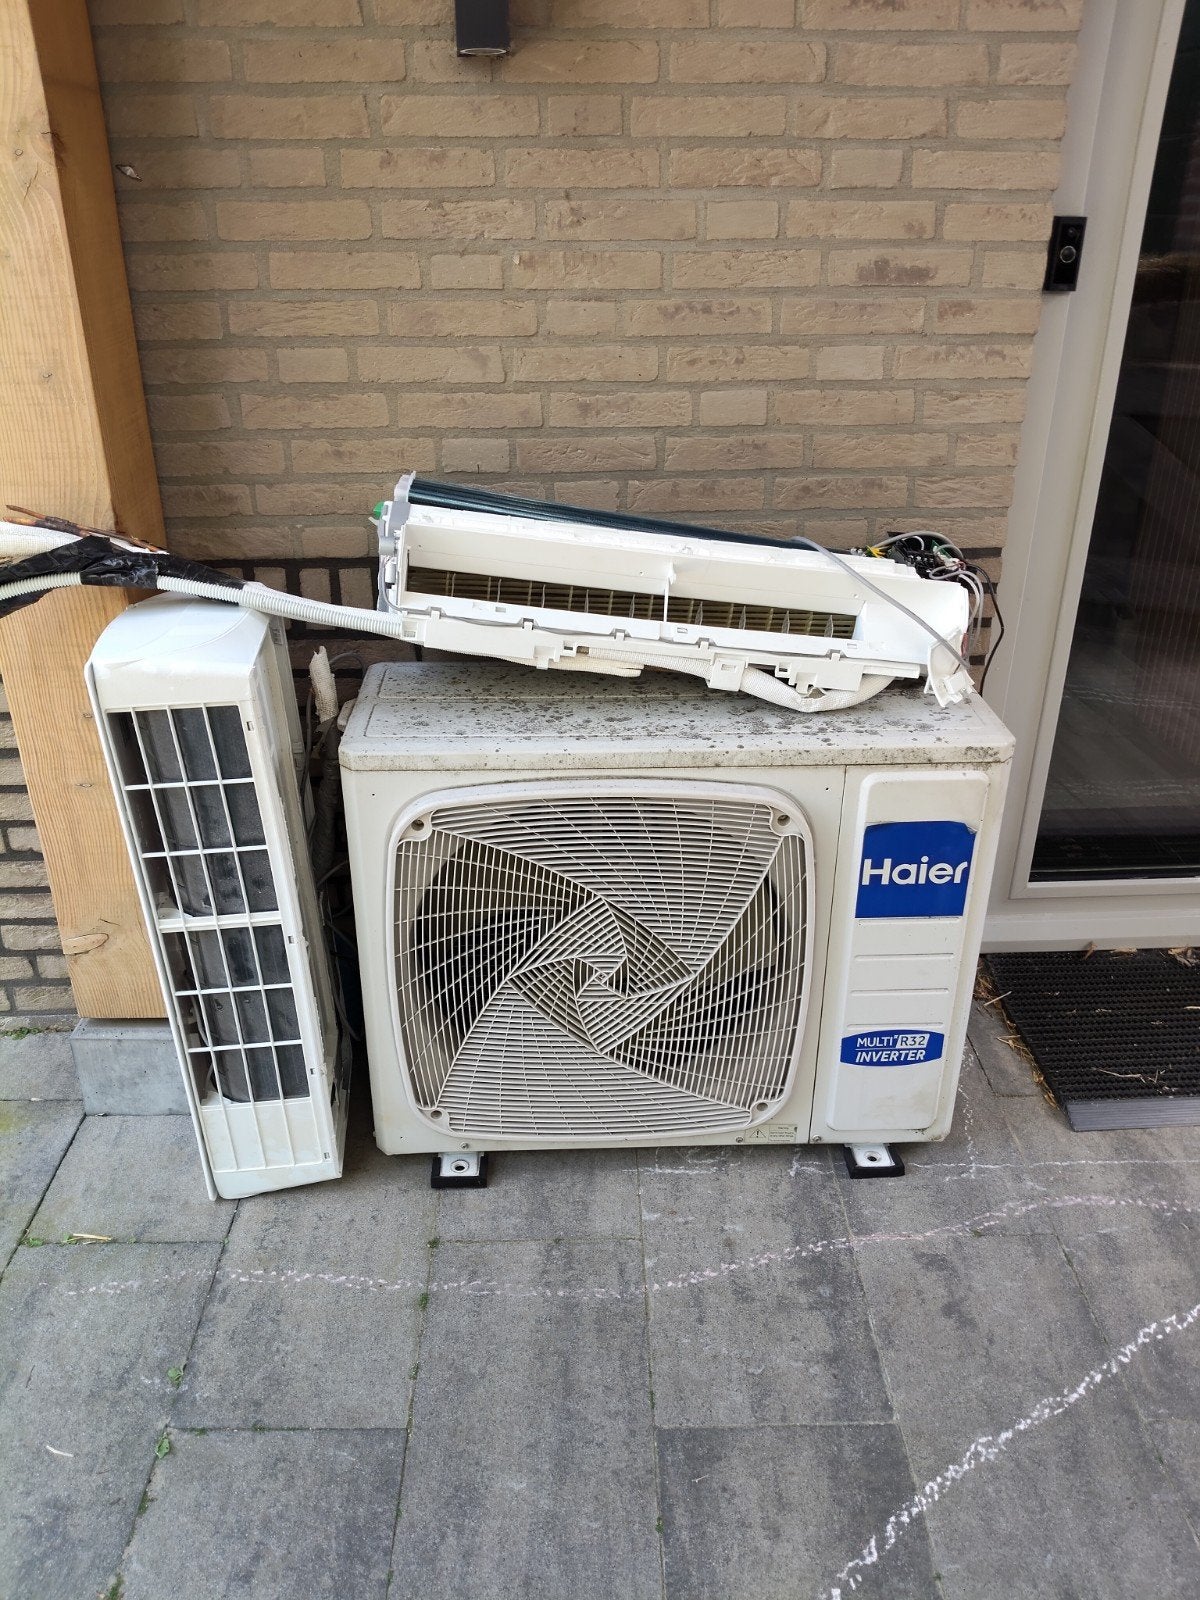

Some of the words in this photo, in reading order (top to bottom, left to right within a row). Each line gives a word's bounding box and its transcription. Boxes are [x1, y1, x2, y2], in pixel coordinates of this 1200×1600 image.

[861, 855, 968, 886] Haier
[900, 1035, 926, 1047] R32
[855, 1049, 926, 1063] INVERTER
